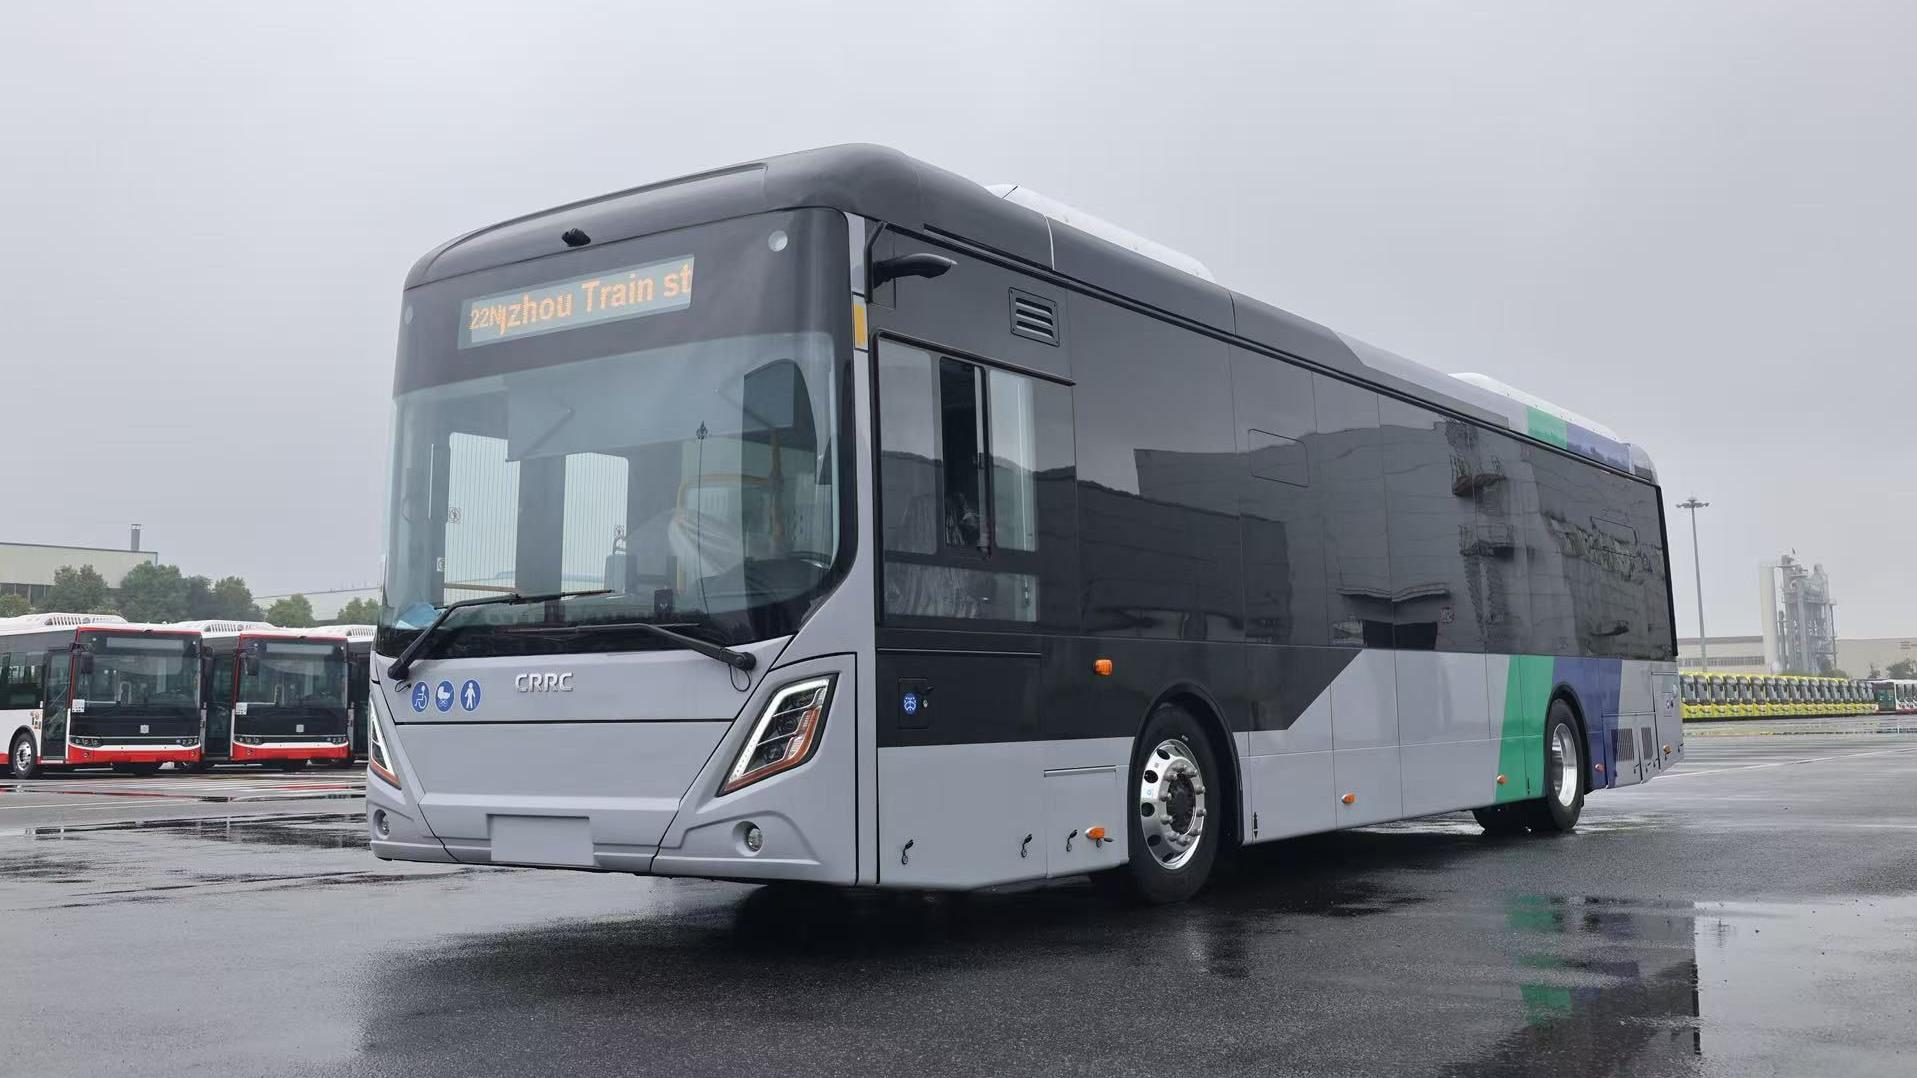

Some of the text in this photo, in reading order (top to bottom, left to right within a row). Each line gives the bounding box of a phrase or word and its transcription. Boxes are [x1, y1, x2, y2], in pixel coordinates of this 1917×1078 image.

[581, 272, 654, 313] Train
[663, 263, 691, 298] st
[514, 672, 574, 692] CRRC
